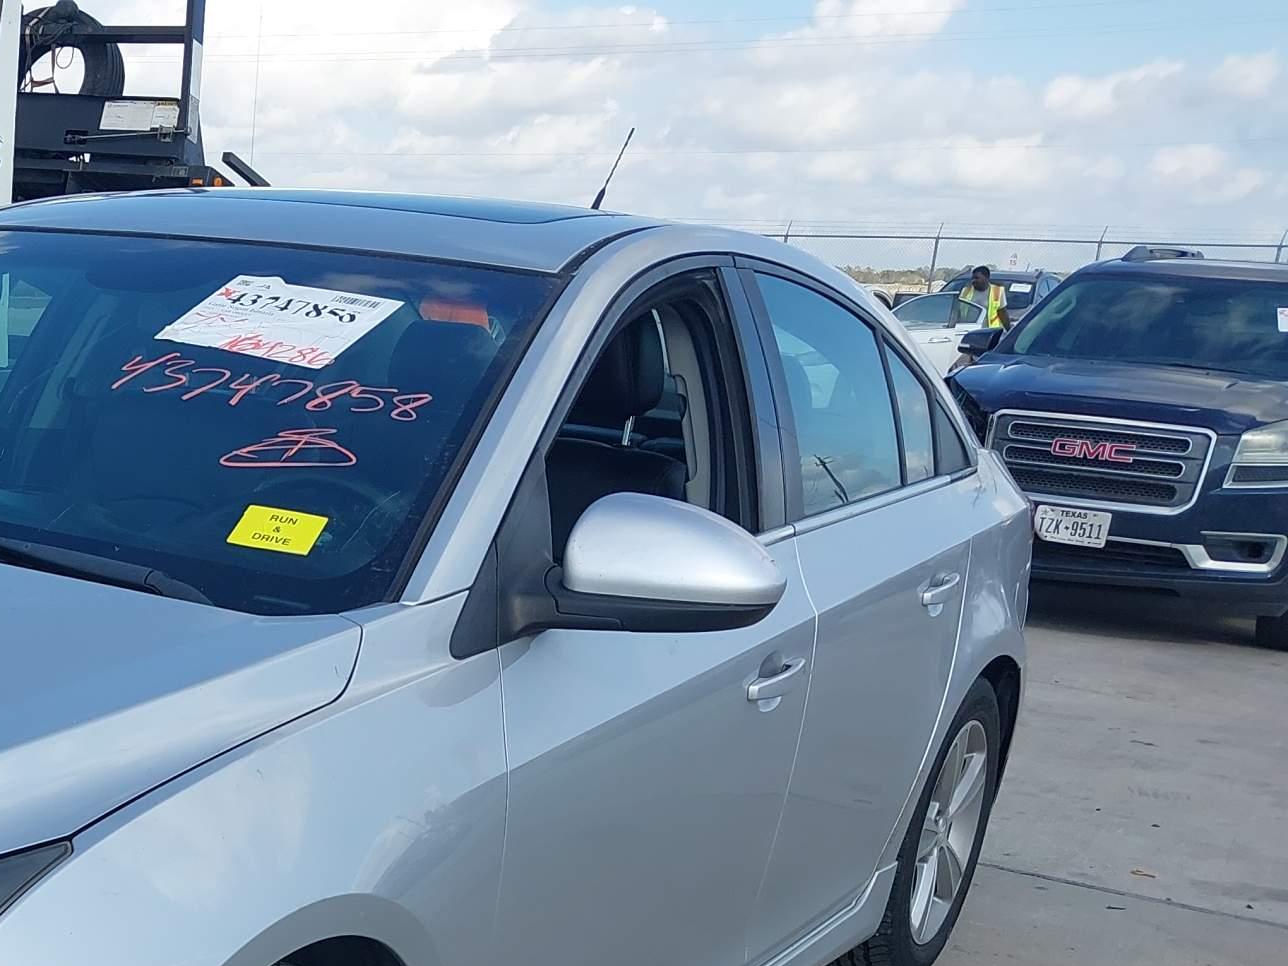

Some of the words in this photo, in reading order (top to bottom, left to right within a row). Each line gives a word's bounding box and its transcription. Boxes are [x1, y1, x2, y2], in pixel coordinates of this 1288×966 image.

[111, 352, 433, 421] 43747858
[1051, 438, 1136, 463] GMC
[269, 514, 298, 525] RUN
[1061, 510, 1088, 519] TEXAS
[251, 532, 292, 546] DRIVE
